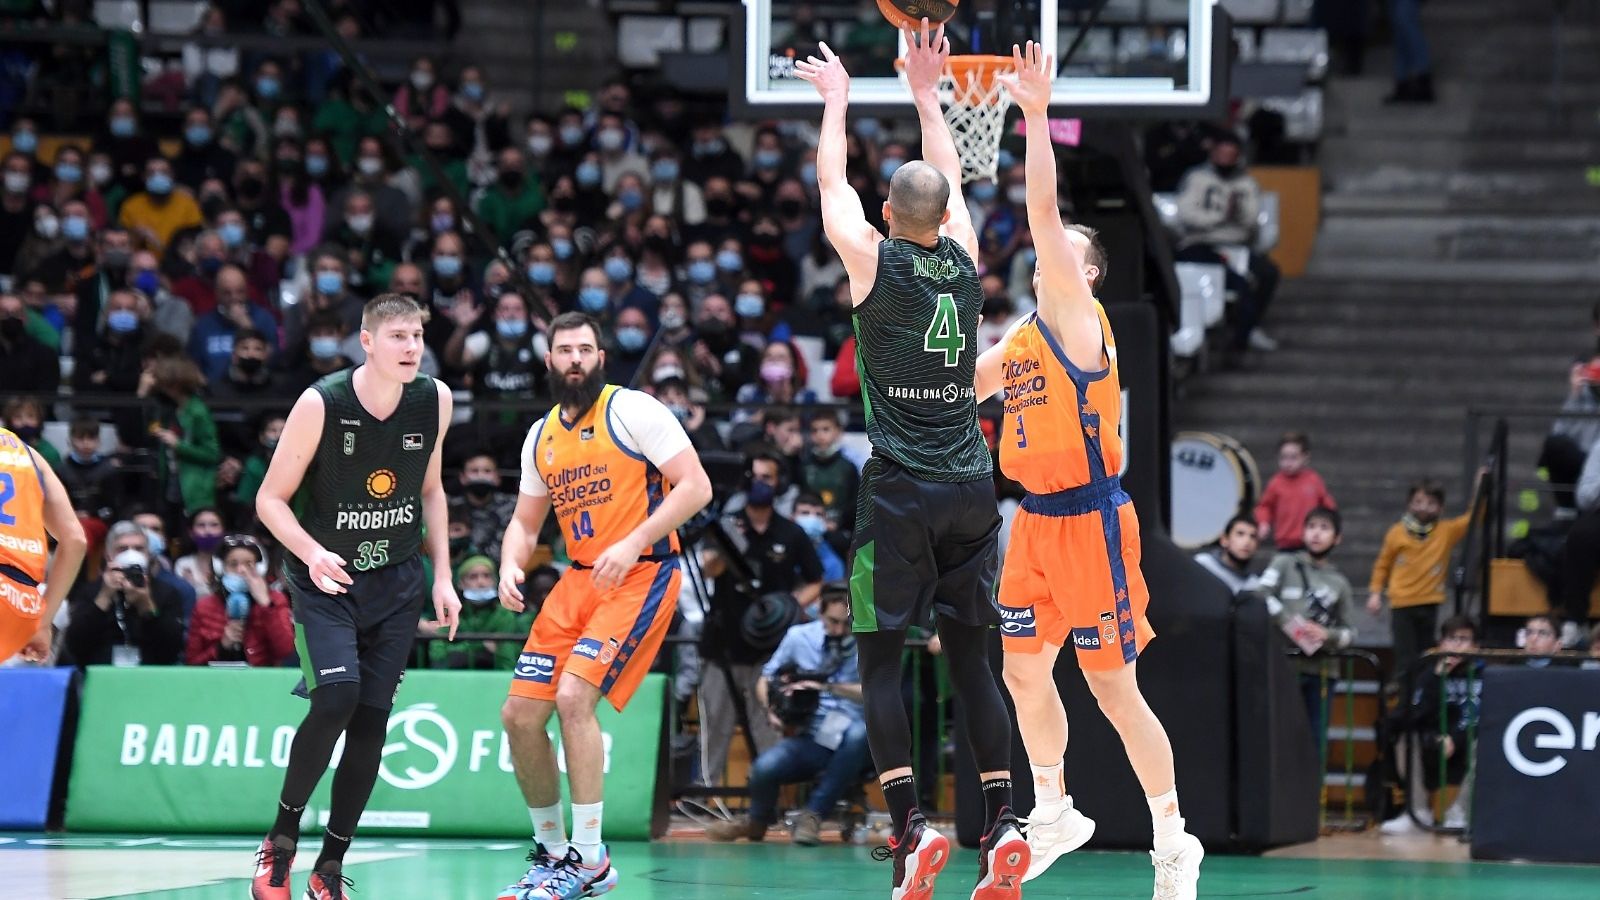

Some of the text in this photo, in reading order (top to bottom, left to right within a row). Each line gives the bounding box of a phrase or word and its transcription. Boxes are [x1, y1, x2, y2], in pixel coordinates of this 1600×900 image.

[924, 293, 965, 367] 4
[888, 386, 940, 399] BADALONA
[1016, 414, 1027, 449] 3
[546, 463, 608, 491] Cultura del
[336, 504, 414, 530] PROBITAS
[572, 510, 595, 541] 14
[353, 539, 389, 572] 35
[120, 723, 347, 769] BADALO
